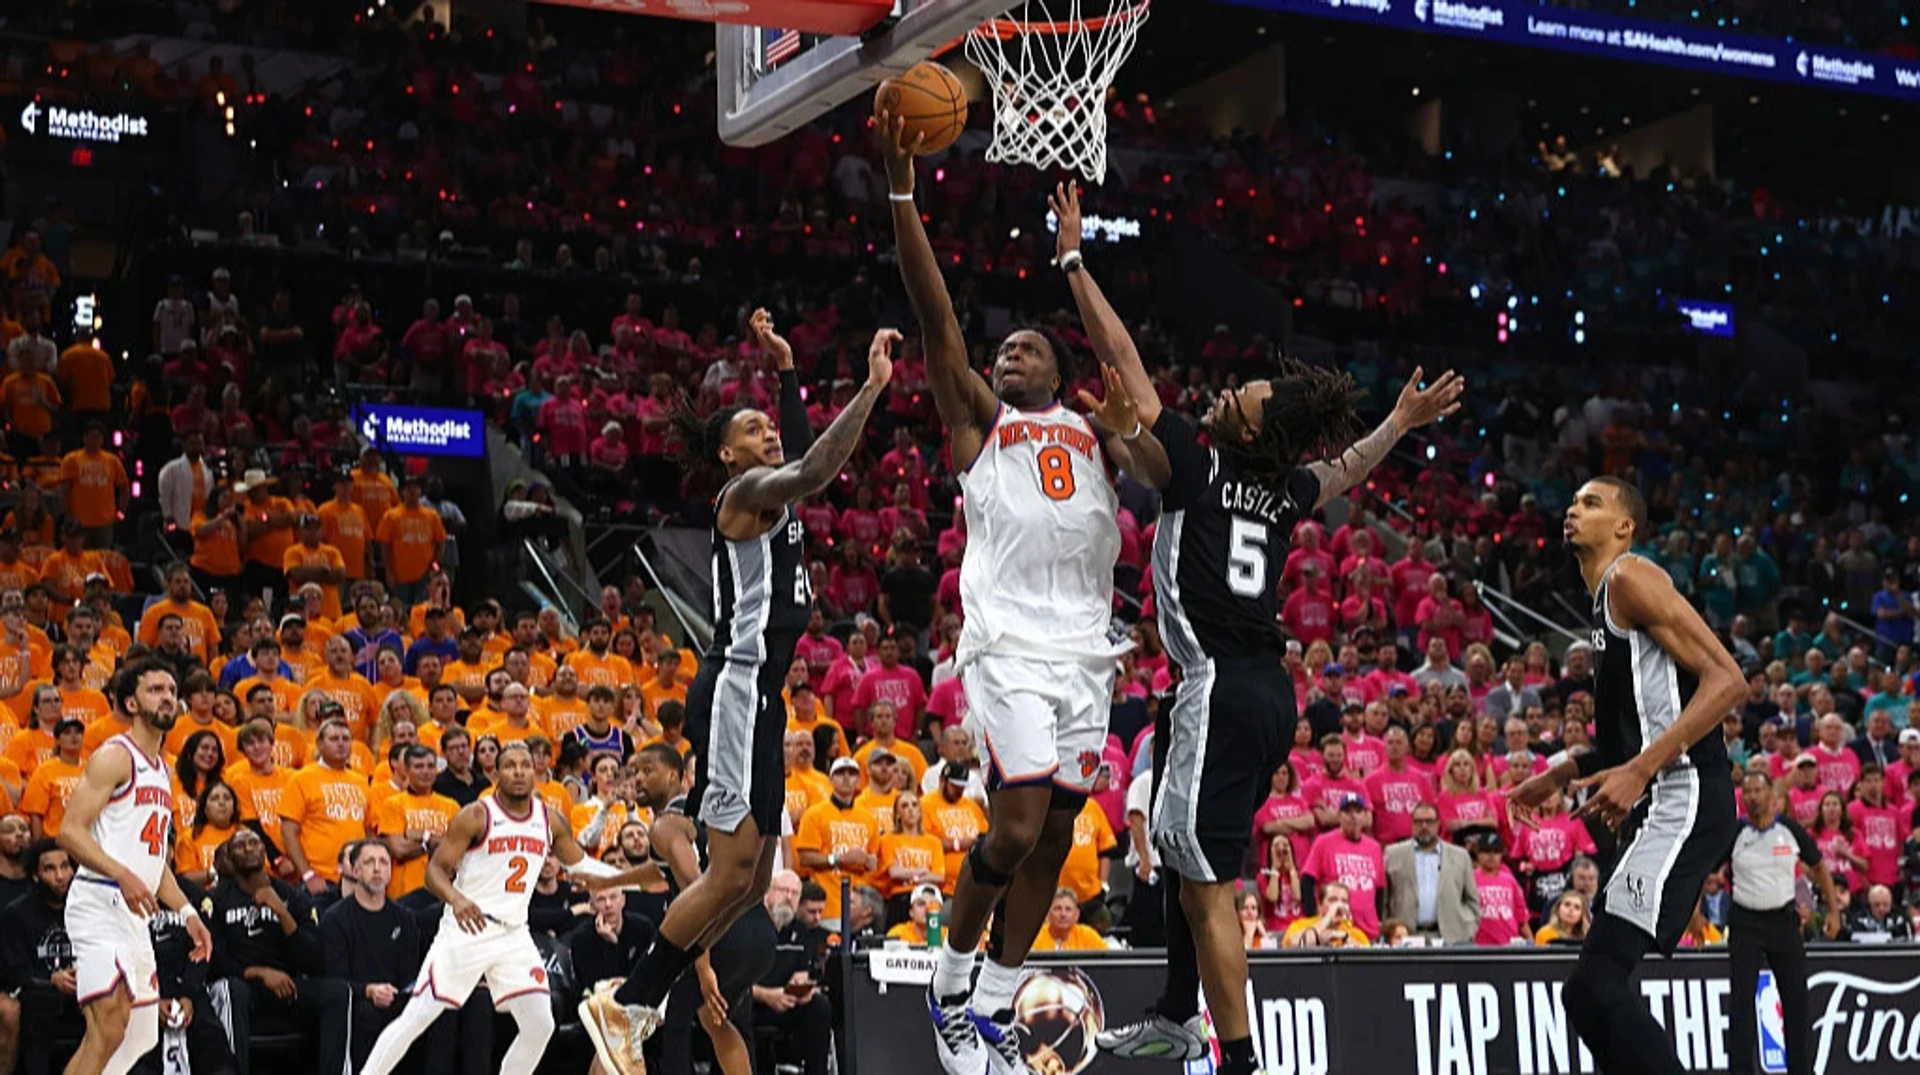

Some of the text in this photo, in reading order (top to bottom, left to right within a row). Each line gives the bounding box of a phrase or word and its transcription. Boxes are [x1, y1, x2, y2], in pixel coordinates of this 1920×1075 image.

[1527, 15, 1567, 37] Learn
[1569, 25, 1605, 43] more
[1606, 31, 1622, 46] at
[48, 106, 147, 137] Methodist
[1080, 213, 1140, 237] ethodist
[386, 416, 471, 440] Methodist
[1036, 445, 1076, 501] 8
[1226, 514, 1268, 599] 5
[504, 855, 529, 894] 2
[1404, 982, 1500, 1075] TAP
[1640, 979, 1732, 1071] THE
